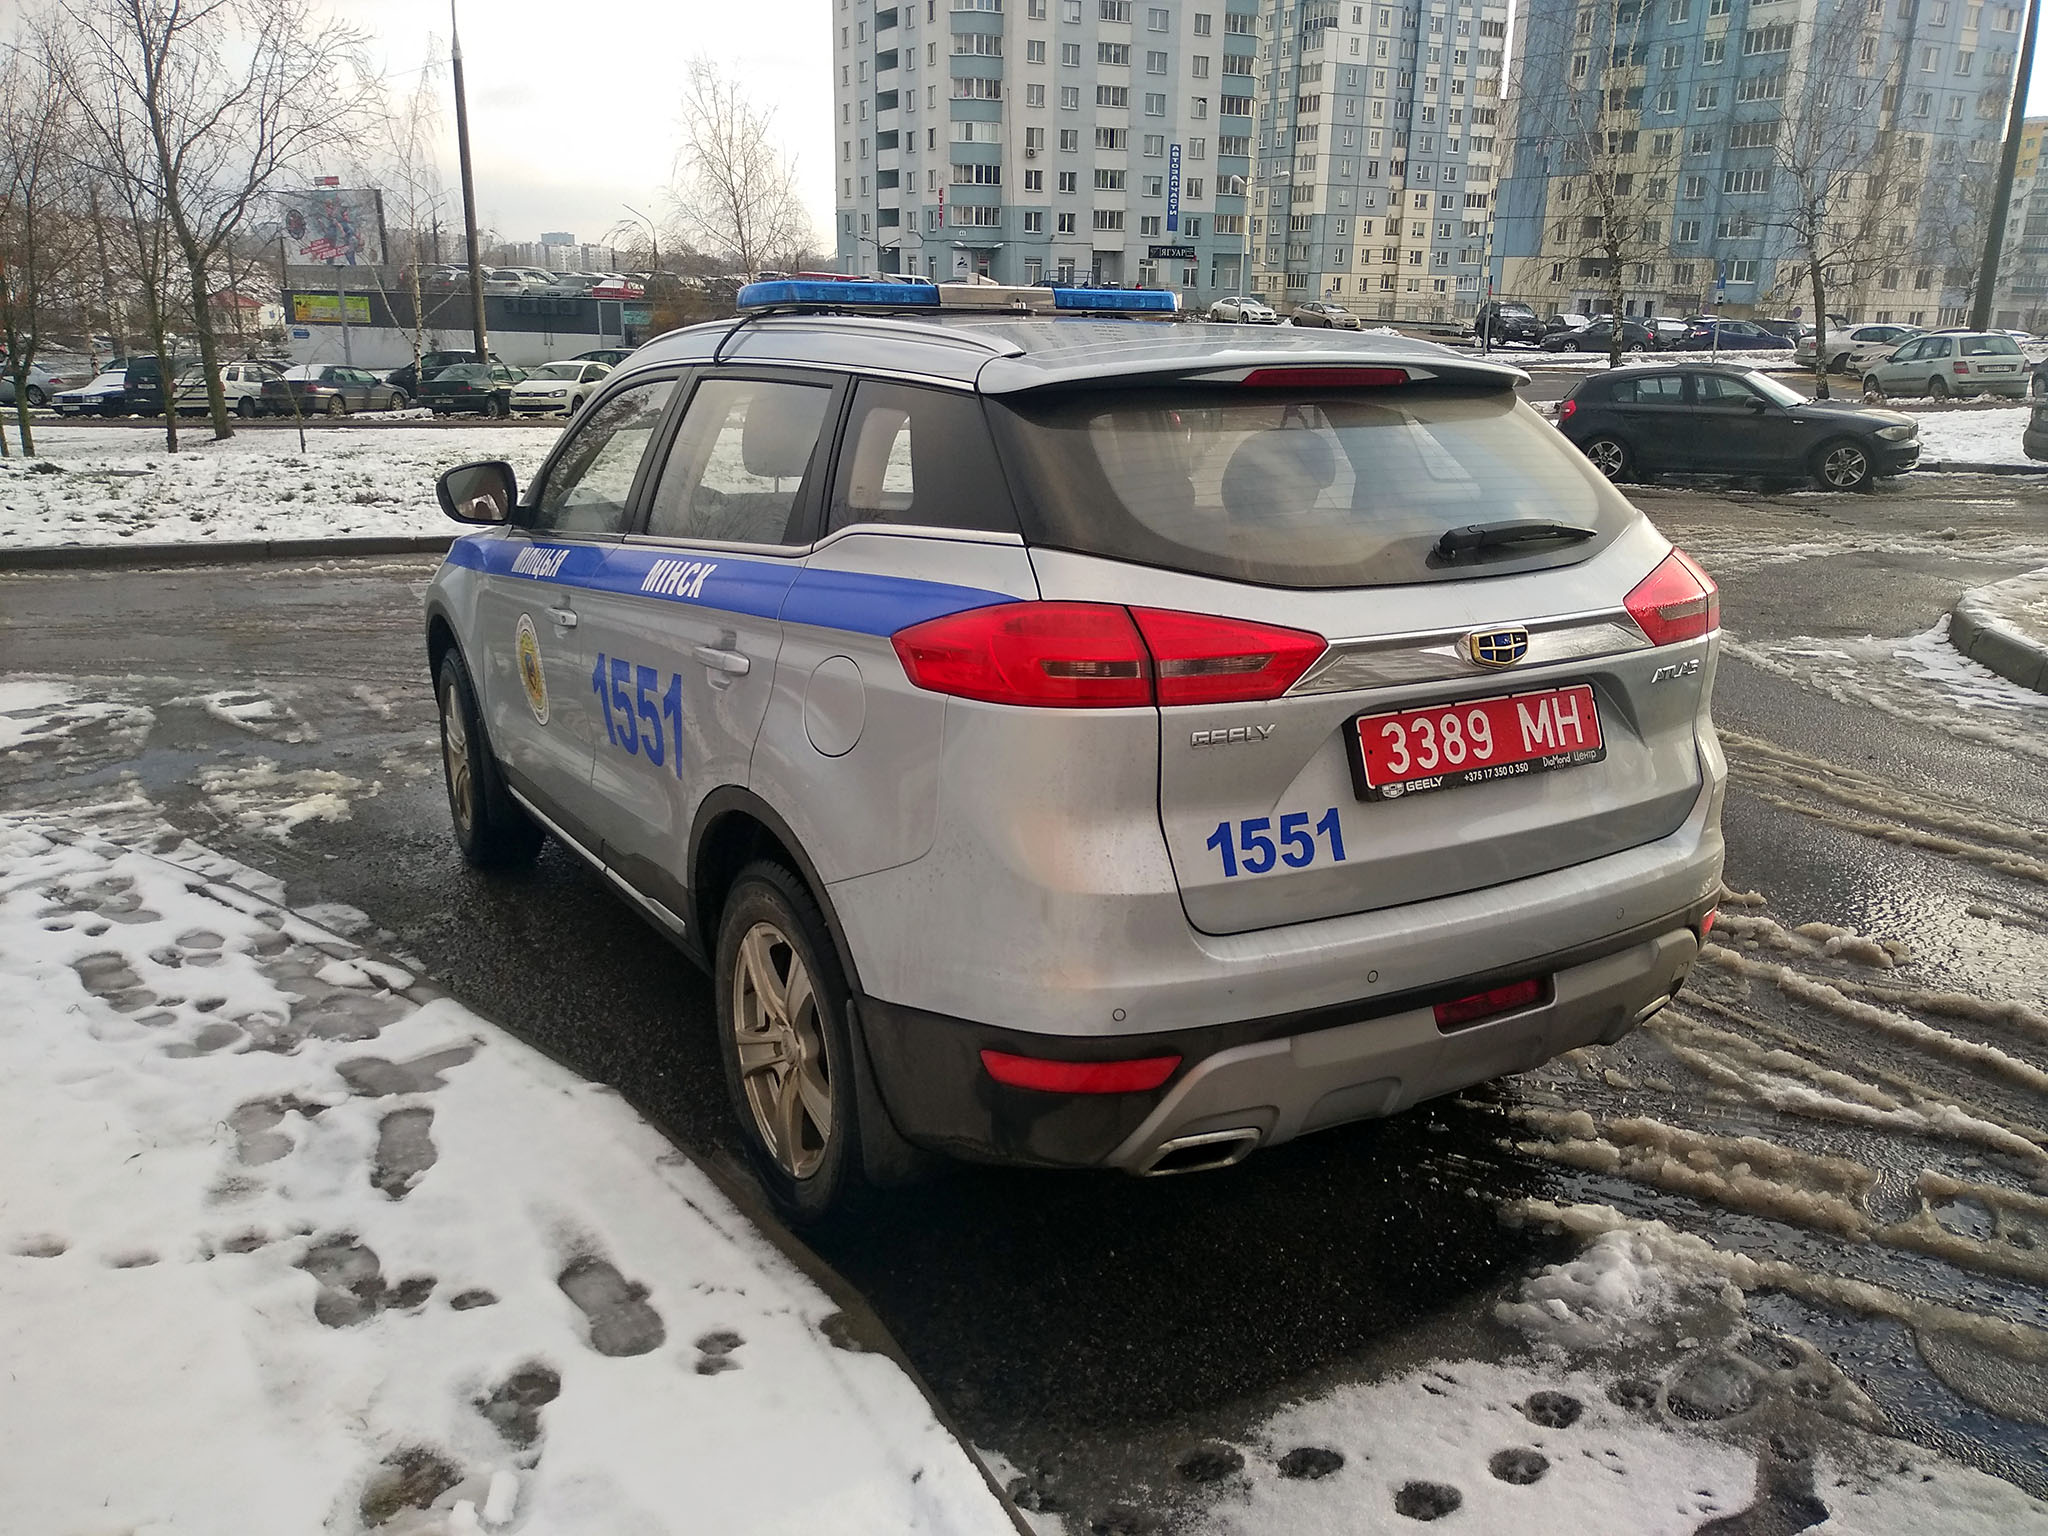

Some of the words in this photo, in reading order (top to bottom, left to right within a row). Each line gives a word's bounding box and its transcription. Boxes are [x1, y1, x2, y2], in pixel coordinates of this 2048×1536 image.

[1170, 145, 1180, 216] АВТОЗАПЧАСТИ
[1161, 248, 1186, 258] ЯГУАР
[592, 652, 682, 781] 1551
[1190, 723, 1276, 748] GEELY
[1381, 709, 1493, 774] 3389
[1405, 775, 1443, 793] GEELY
[1464, 770, 1483, 782] +375
[1484, 768, 1493, 780] 17
[1494, 766, 1508, 777] 350
[1508, 765, 1514, 775] 0
[1515, 762, 1529, 773] 350
[1206, 807, 1346, 878] 1551
